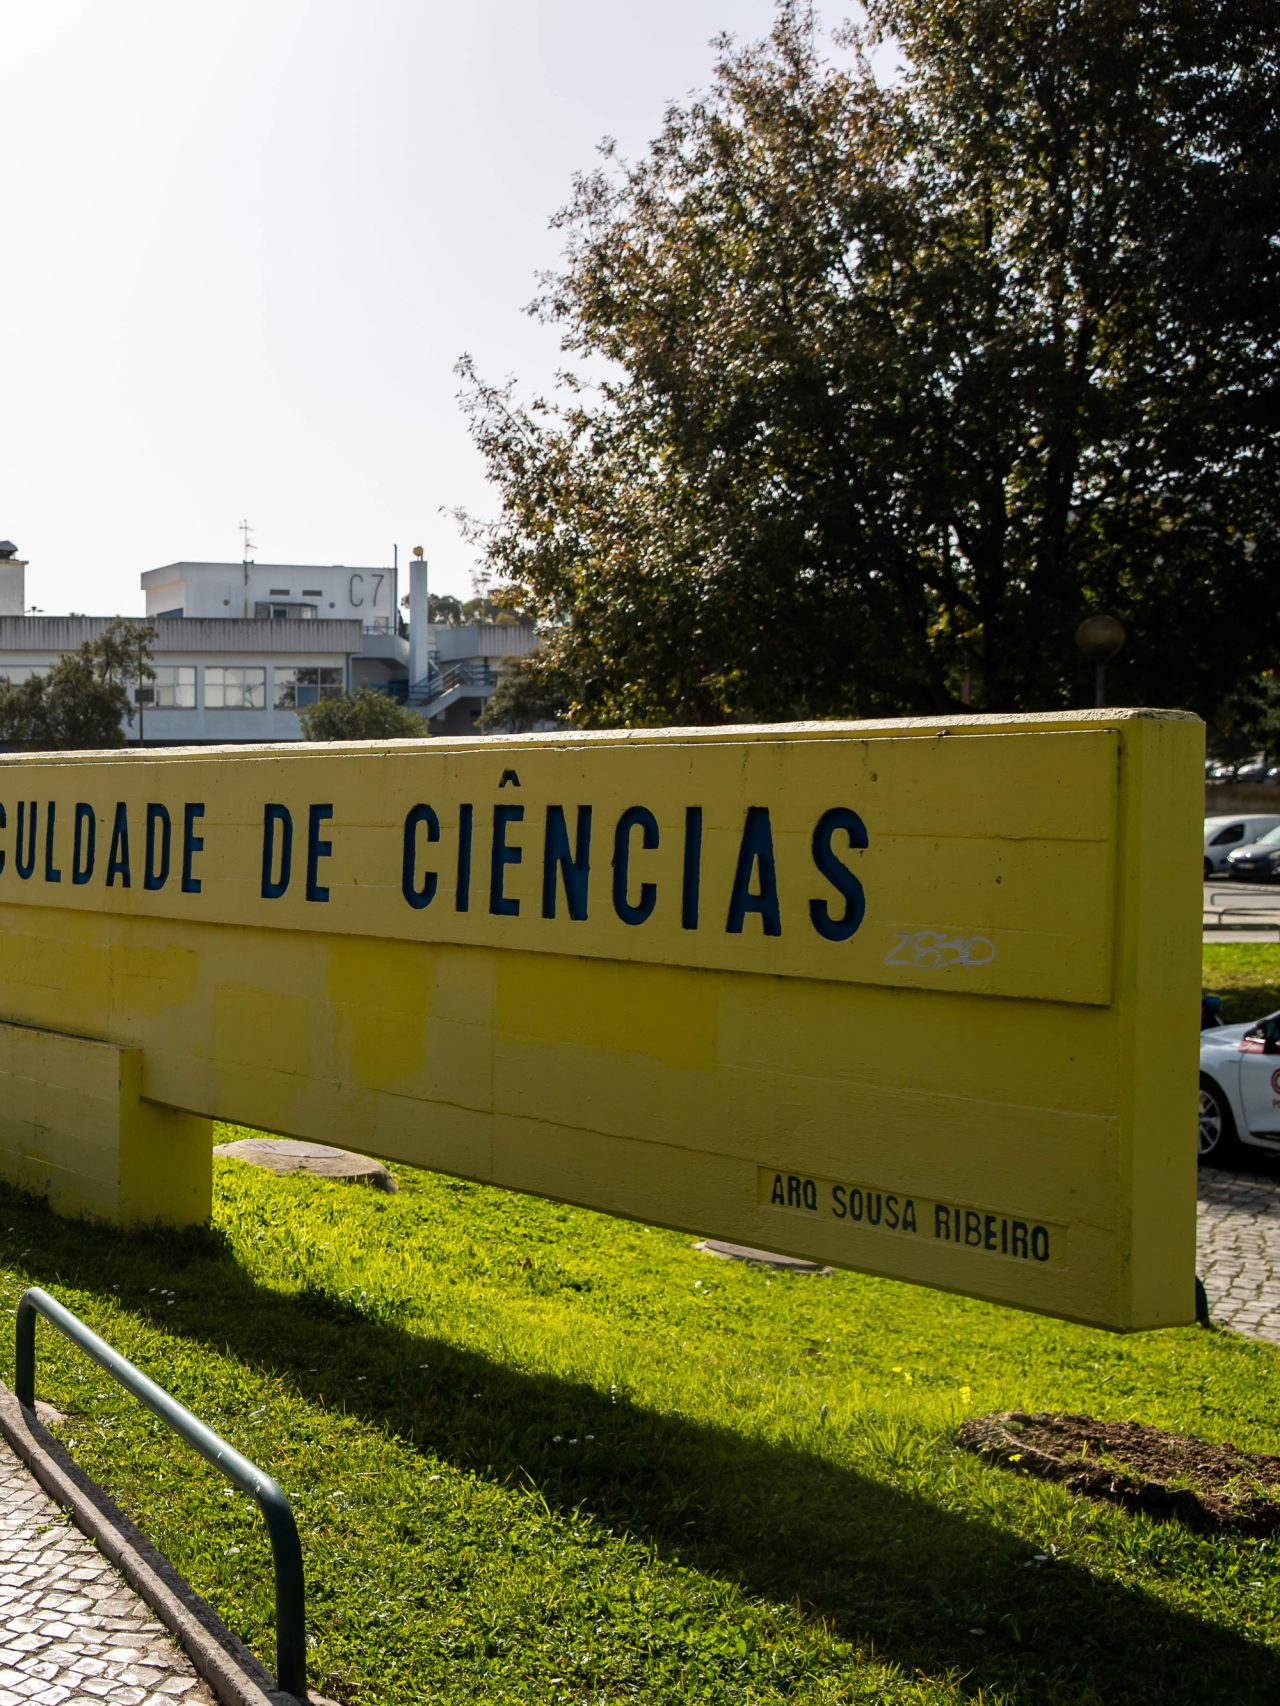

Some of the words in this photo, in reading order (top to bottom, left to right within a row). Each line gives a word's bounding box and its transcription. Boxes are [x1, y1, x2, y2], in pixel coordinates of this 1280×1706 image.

[350, 574, 385, 607] C7
[261, 803, 333, 902] DE
[401, 769, 869, 942] CIÊNCIAS
[771, 1174, 818, 1211] ARQ
[831, 1185, 917, 1233] SOUSA
[934, 1204, 1050, 1262] RIBEIRO
